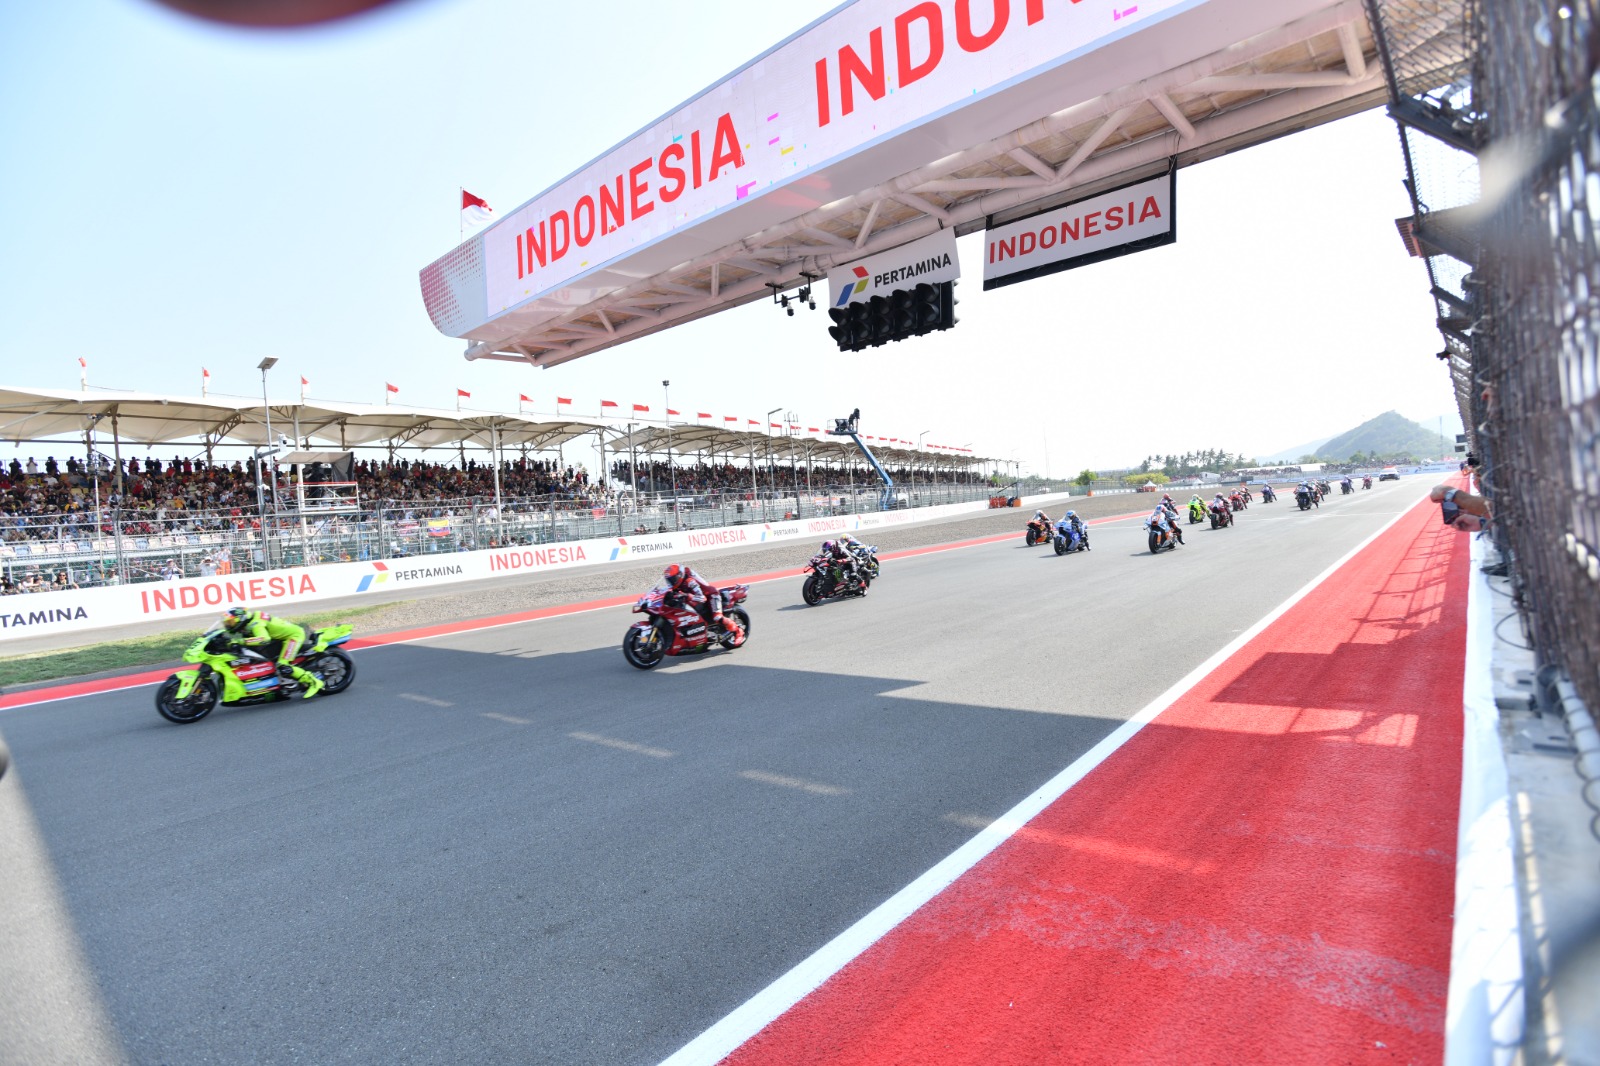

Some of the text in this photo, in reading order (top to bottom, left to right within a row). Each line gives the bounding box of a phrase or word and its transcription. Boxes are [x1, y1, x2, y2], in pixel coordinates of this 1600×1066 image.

[516, 113, 745, 281] INDONESIA
[989, 196, 1162, 264] INDONESIA
[873, 252, 953, 288] PERTAMINA
[688, 529, 747, 548] INDONESIA
[807, 519, 847, 533] INDONESIA
[489, 545, 587, 572] INDONESIA
[631, 541, 673, 554] PERTAMINA
[395, 565, 463, 581] PERTAMINA
[141, 573, 317, 614] INDONESIA
